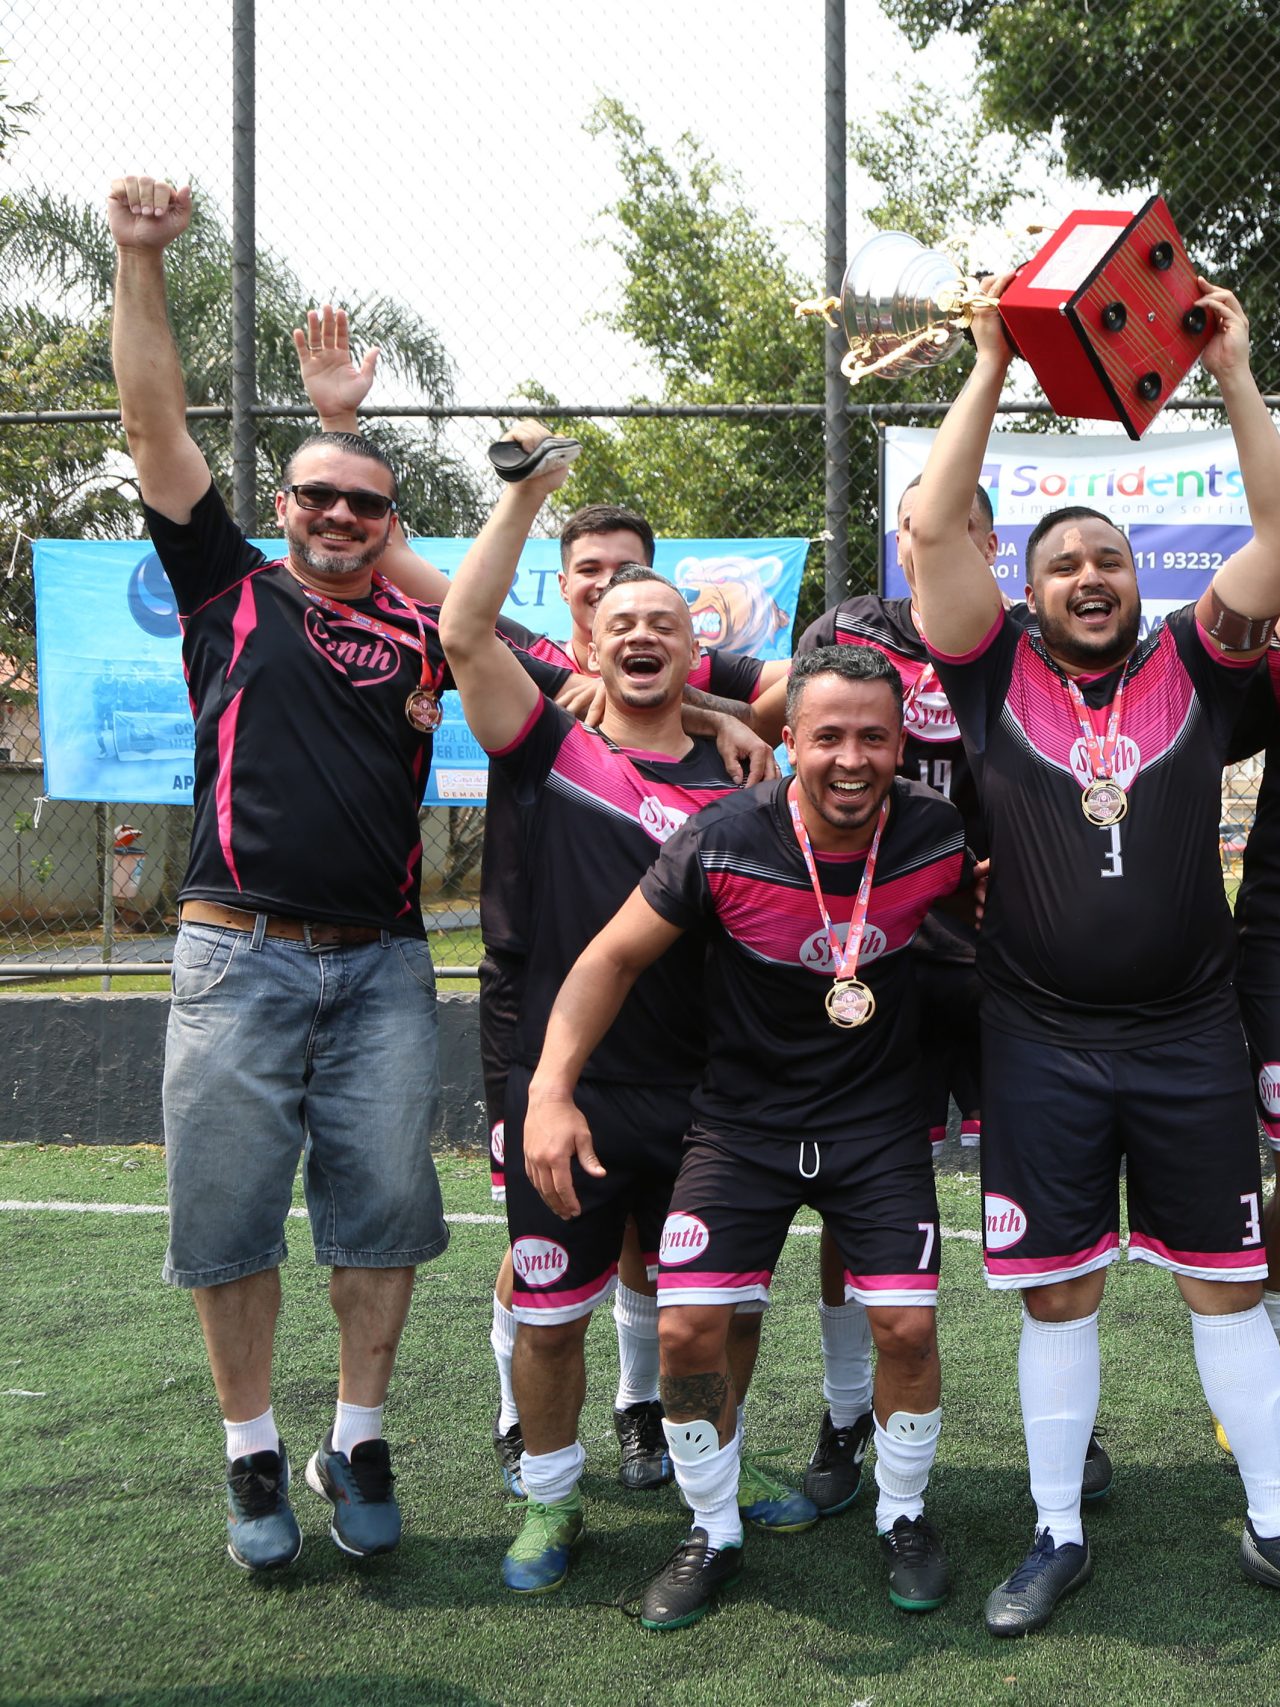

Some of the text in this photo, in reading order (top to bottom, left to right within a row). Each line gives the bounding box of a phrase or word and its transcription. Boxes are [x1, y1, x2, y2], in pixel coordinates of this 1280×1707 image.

[1010, 463, 1245, 498] Sorridents
[1109, 503, 1165, 515] como
[1134, 551, 1156, 569] 11
[1098, 822, 1124, 878] 3
[1239, 1192, 1262, 1246] 3
[515, 1246, 565, 1277] Synth
[917, 1222, 935, 1270] 7
